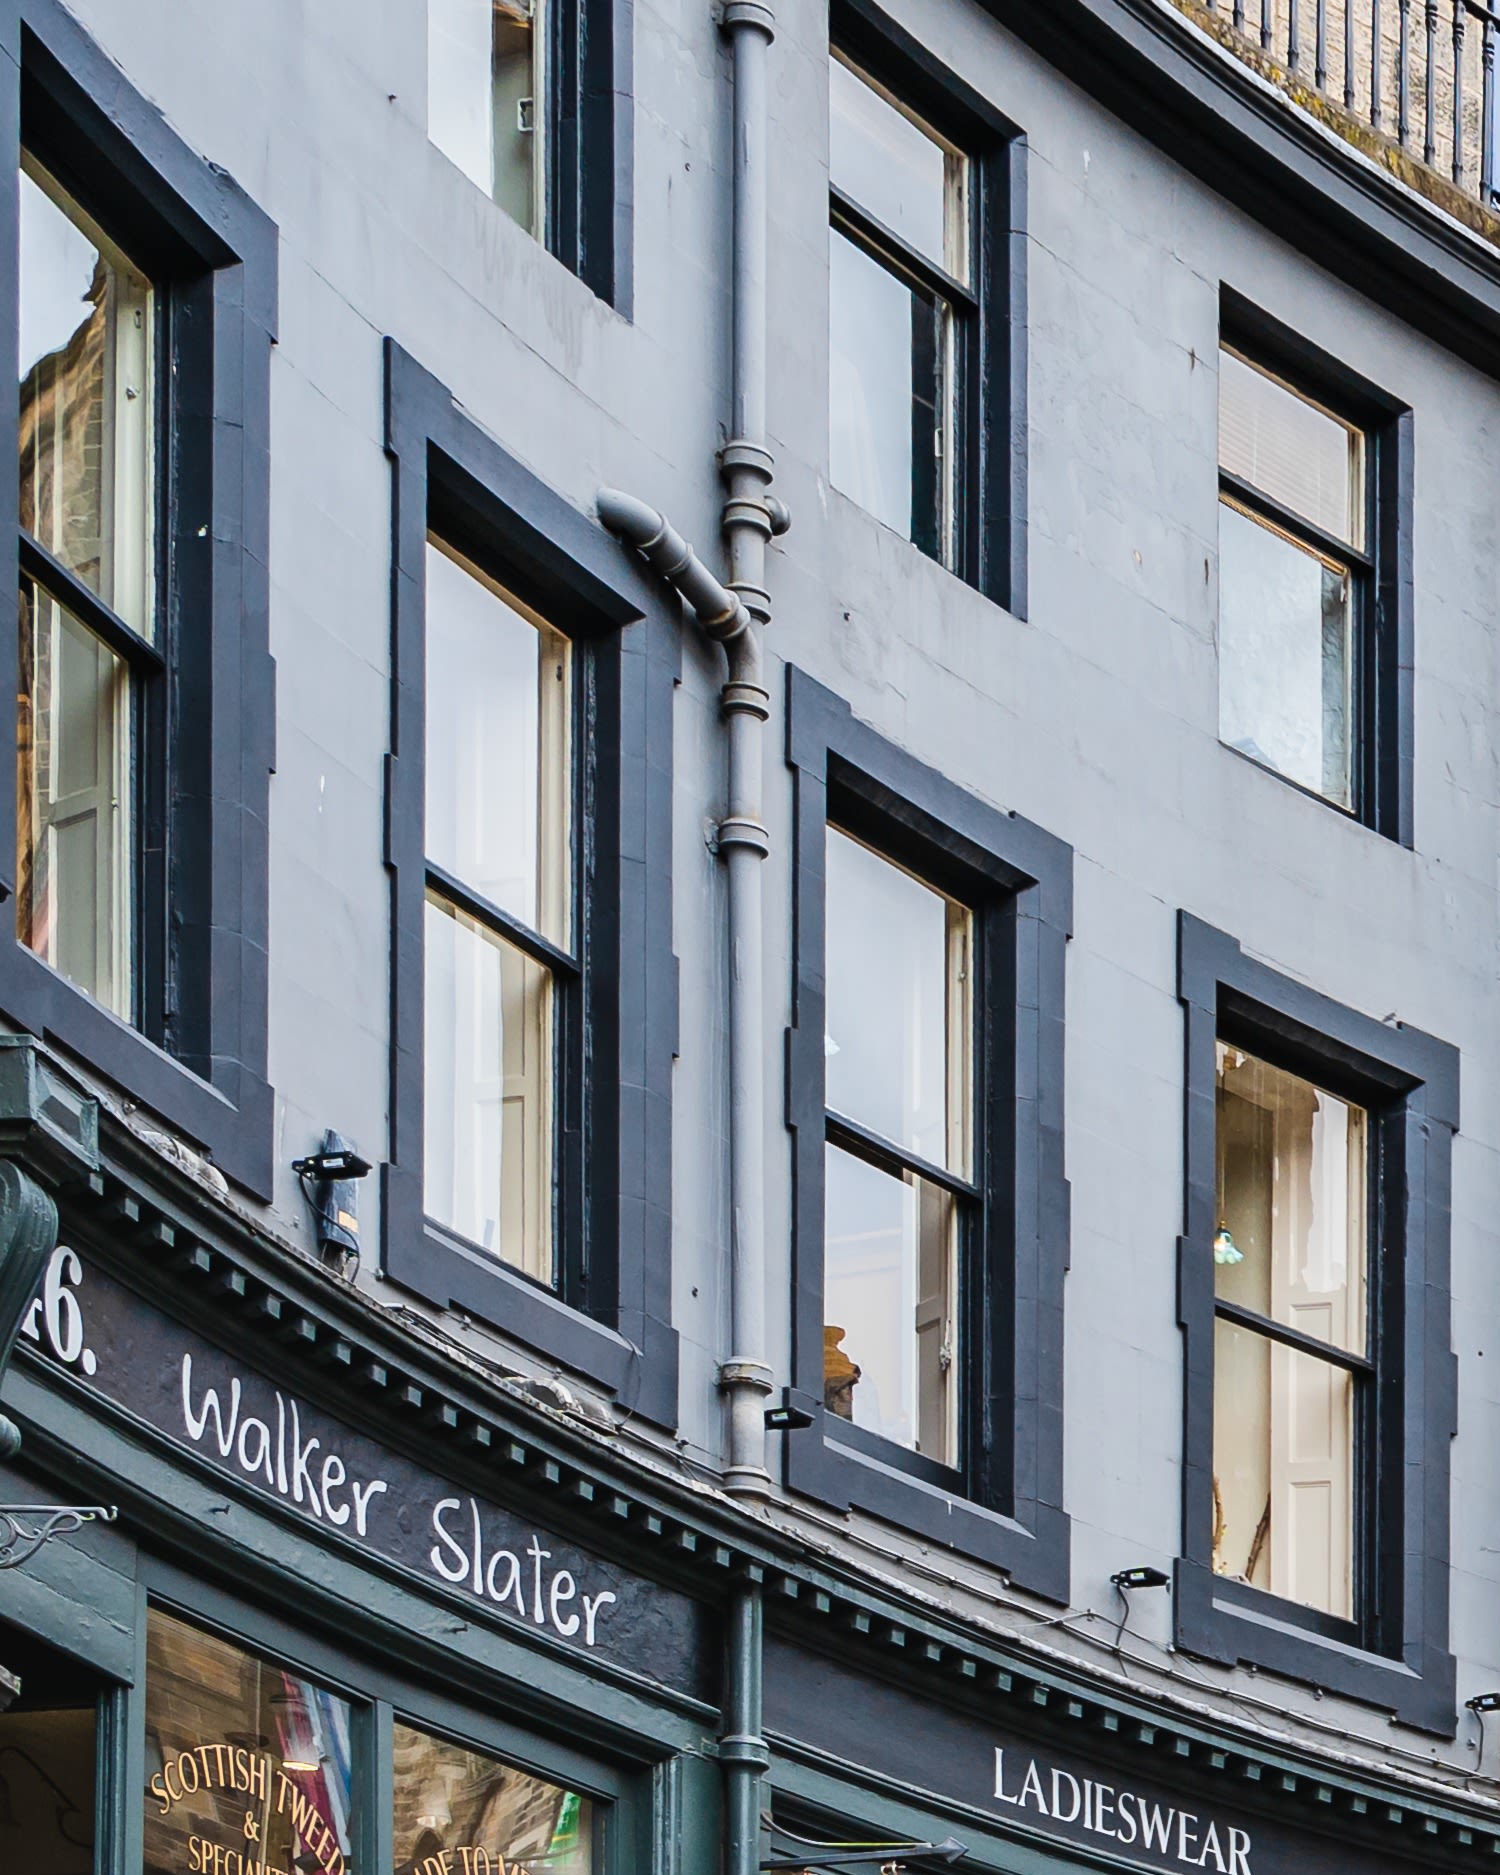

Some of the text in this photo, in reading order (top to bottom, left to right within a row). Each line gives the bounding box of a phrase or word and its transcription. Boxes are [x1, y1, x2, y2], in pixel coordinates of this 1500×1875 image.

[181, 1353, 617, 1646] Walker Slater
[151, 1744, 265, 1815] SCOTTISH
[244, 1811, 260, 1842] &
